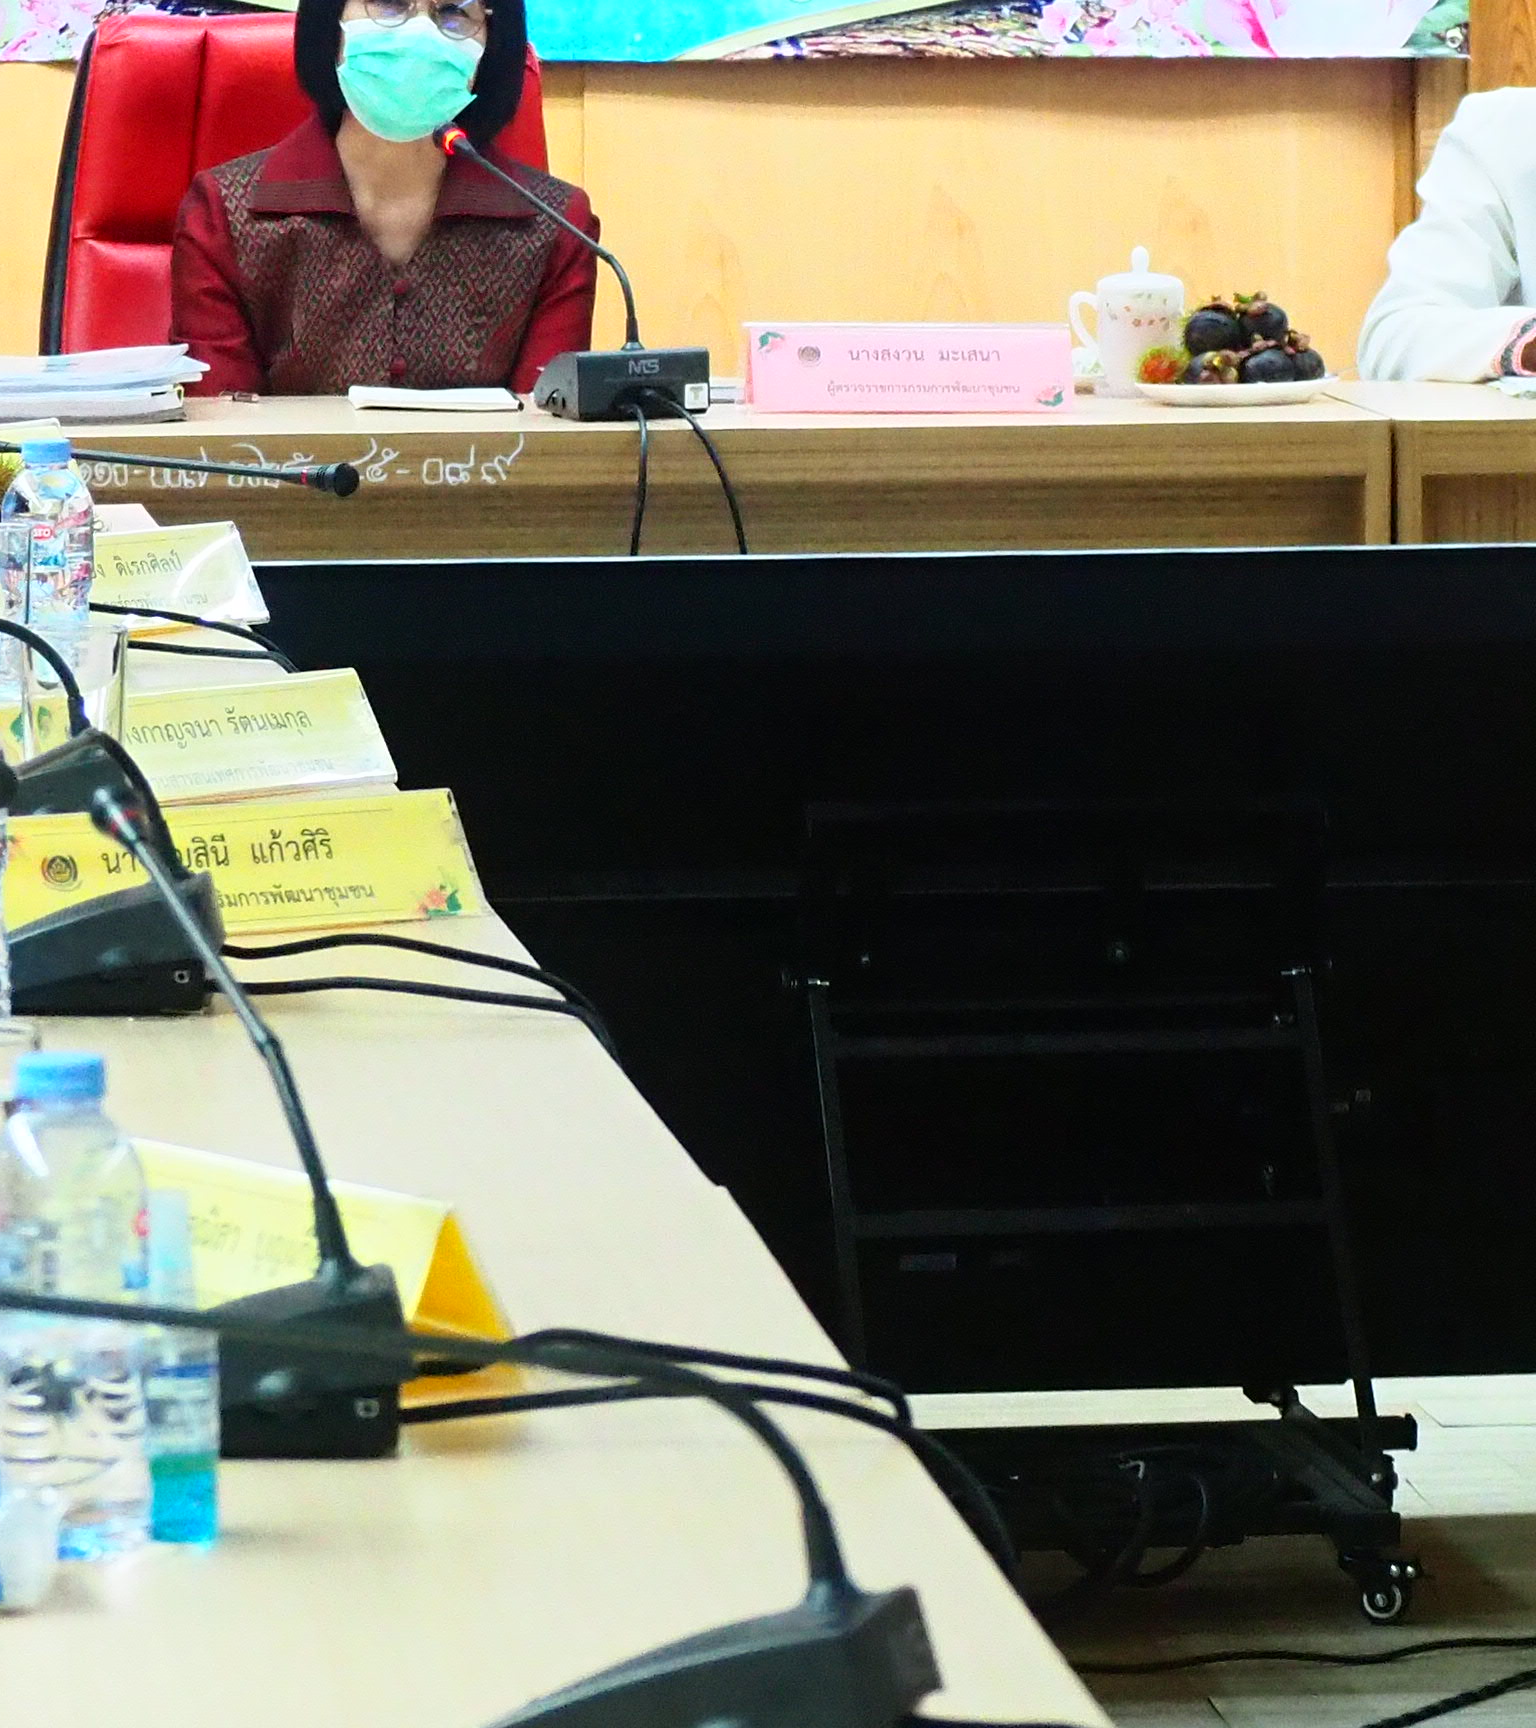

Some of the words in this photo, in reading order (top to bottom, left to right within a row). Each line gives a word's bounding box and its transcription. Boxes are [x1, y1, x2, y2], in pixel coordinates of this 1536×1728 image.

[125, 718, 224, 750] างกาญจนา
[250, 827, 335, 865] แก้วศิริ
[216, 883, 376, 910] ริมการพัฒนาชุมชน
